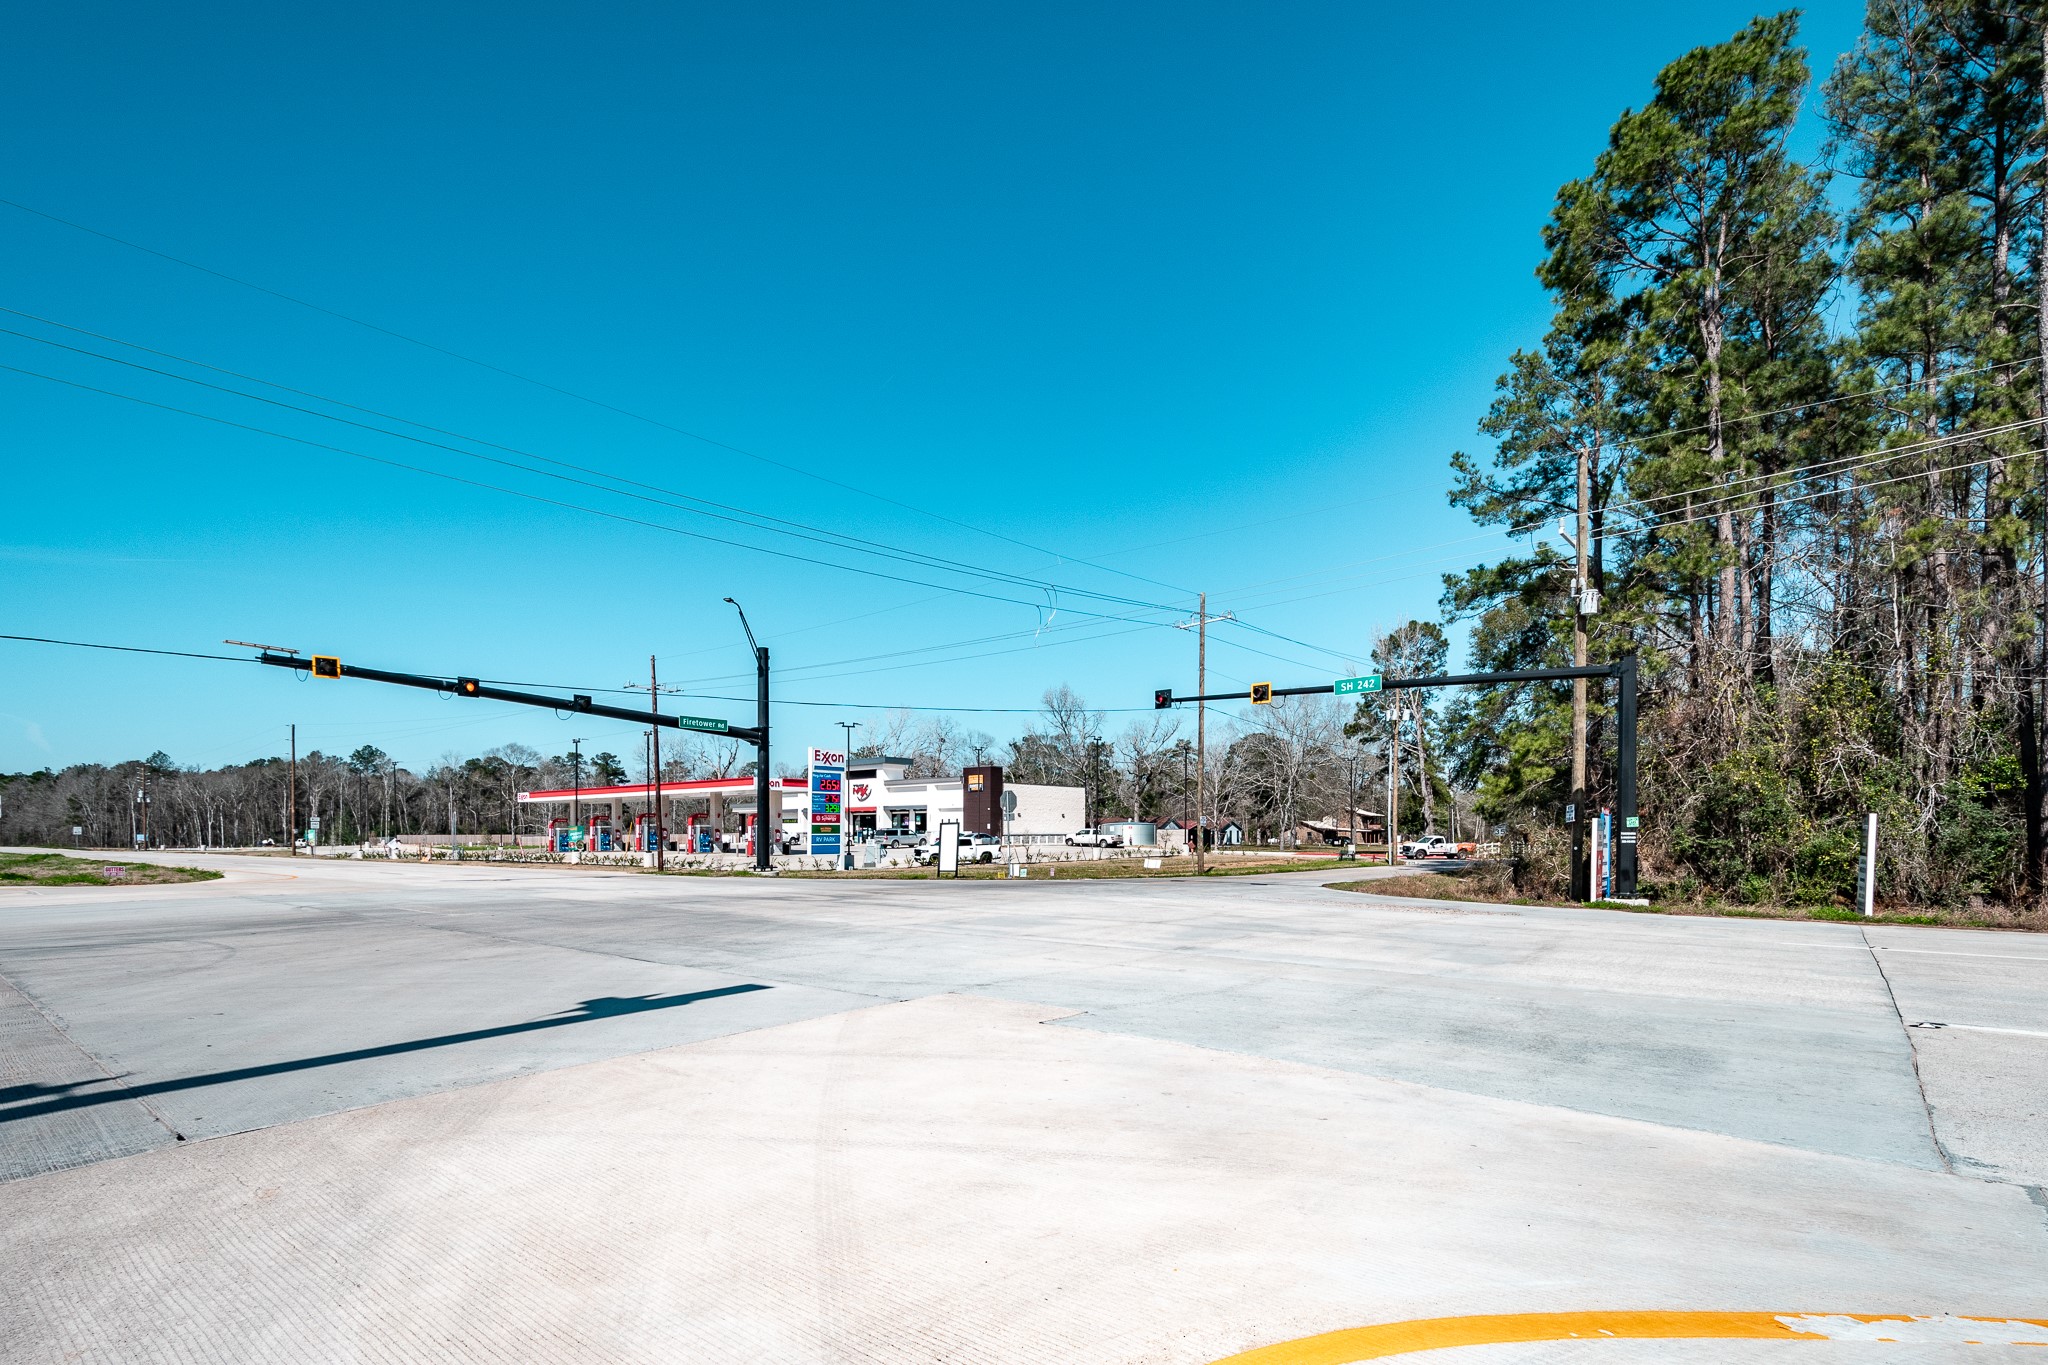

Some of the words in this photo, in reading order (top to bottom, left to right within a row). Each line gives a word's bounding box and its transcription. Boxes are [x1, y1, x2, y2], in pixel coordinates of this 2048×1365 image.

[1341, 682, 1353, 691] SH
[1357, 679, 1375, 690] 242
[683, 718, 716, 728] Firetower
[815, 750, 844, 766] Exxon
